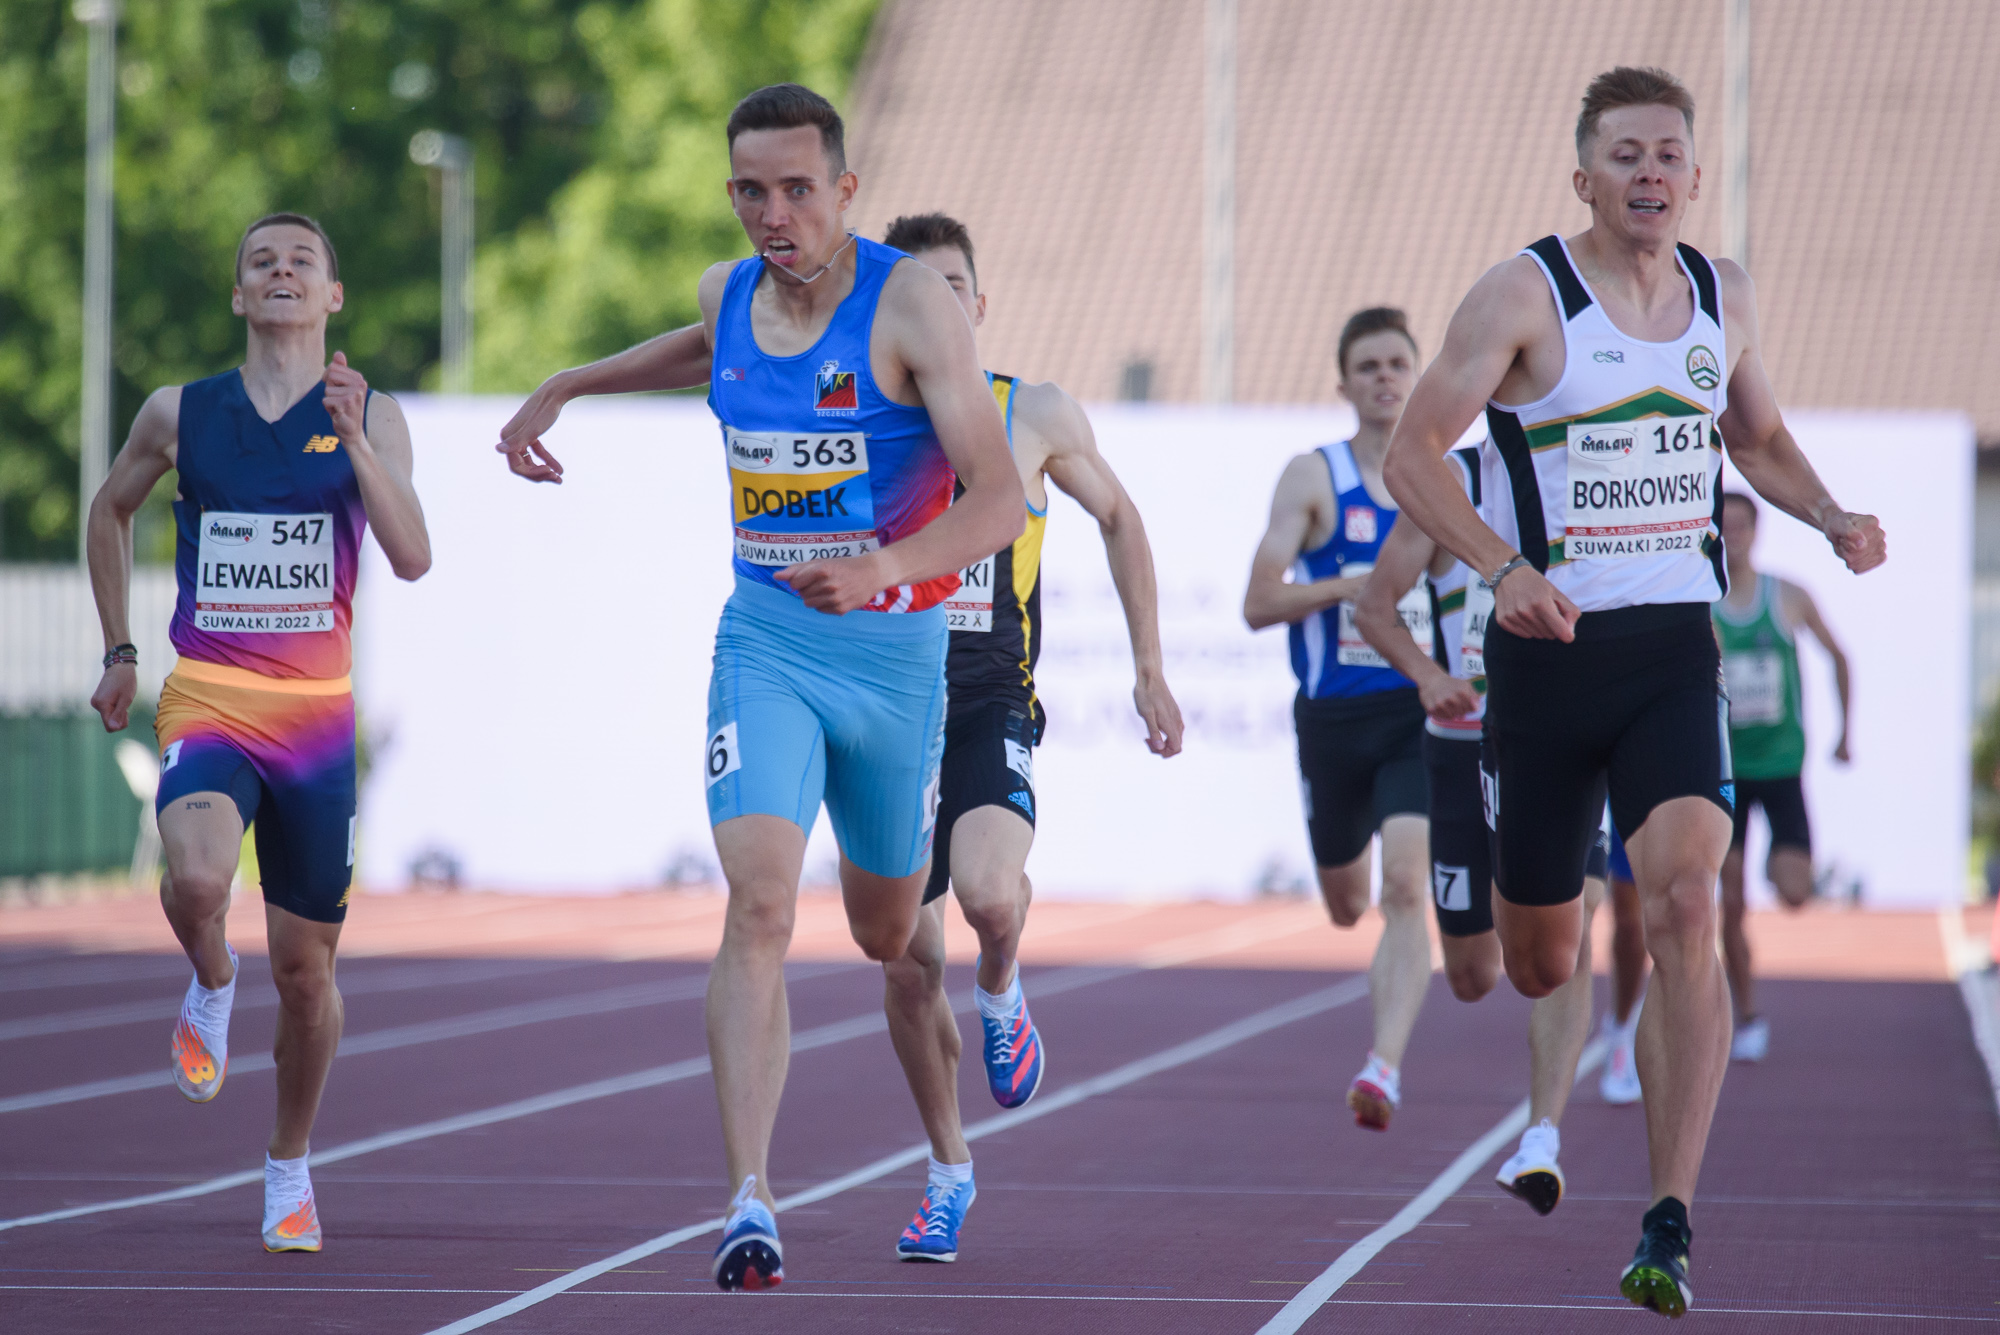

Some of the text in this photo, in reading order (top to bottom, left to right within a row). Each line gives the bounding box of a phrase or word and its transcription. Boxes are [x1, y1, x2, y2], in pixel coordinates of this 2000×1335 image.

[1593, 350, 1625, 363] esa
[816, 410, 856, 418] SZCZECIN
[1653, 421, 1705, 455] 161
[792, 438, 857, 468] 563
[742, 486, 850, 518] DOBEK
[1573, 472, 1707, 510] BORKOWSKI
[271, 519, 325, 546] 547
[769, 534, 835, 543] MISTRZOSTWA
[837, 532, 872, 541] POLSKI
[1574, 535, 1692, 555] SUWAŁKI 2022
[740, 543, 852, 562] SUWAŁKI 2022
[202, 562, 329, 589] LEWALSKI
[202, 615, 311, 629] SUWAŁKI 2022
[708, 734, 728, 778] 6
[186, 801, 211, 810] run
[1439, 870, 1457, 905] 7
